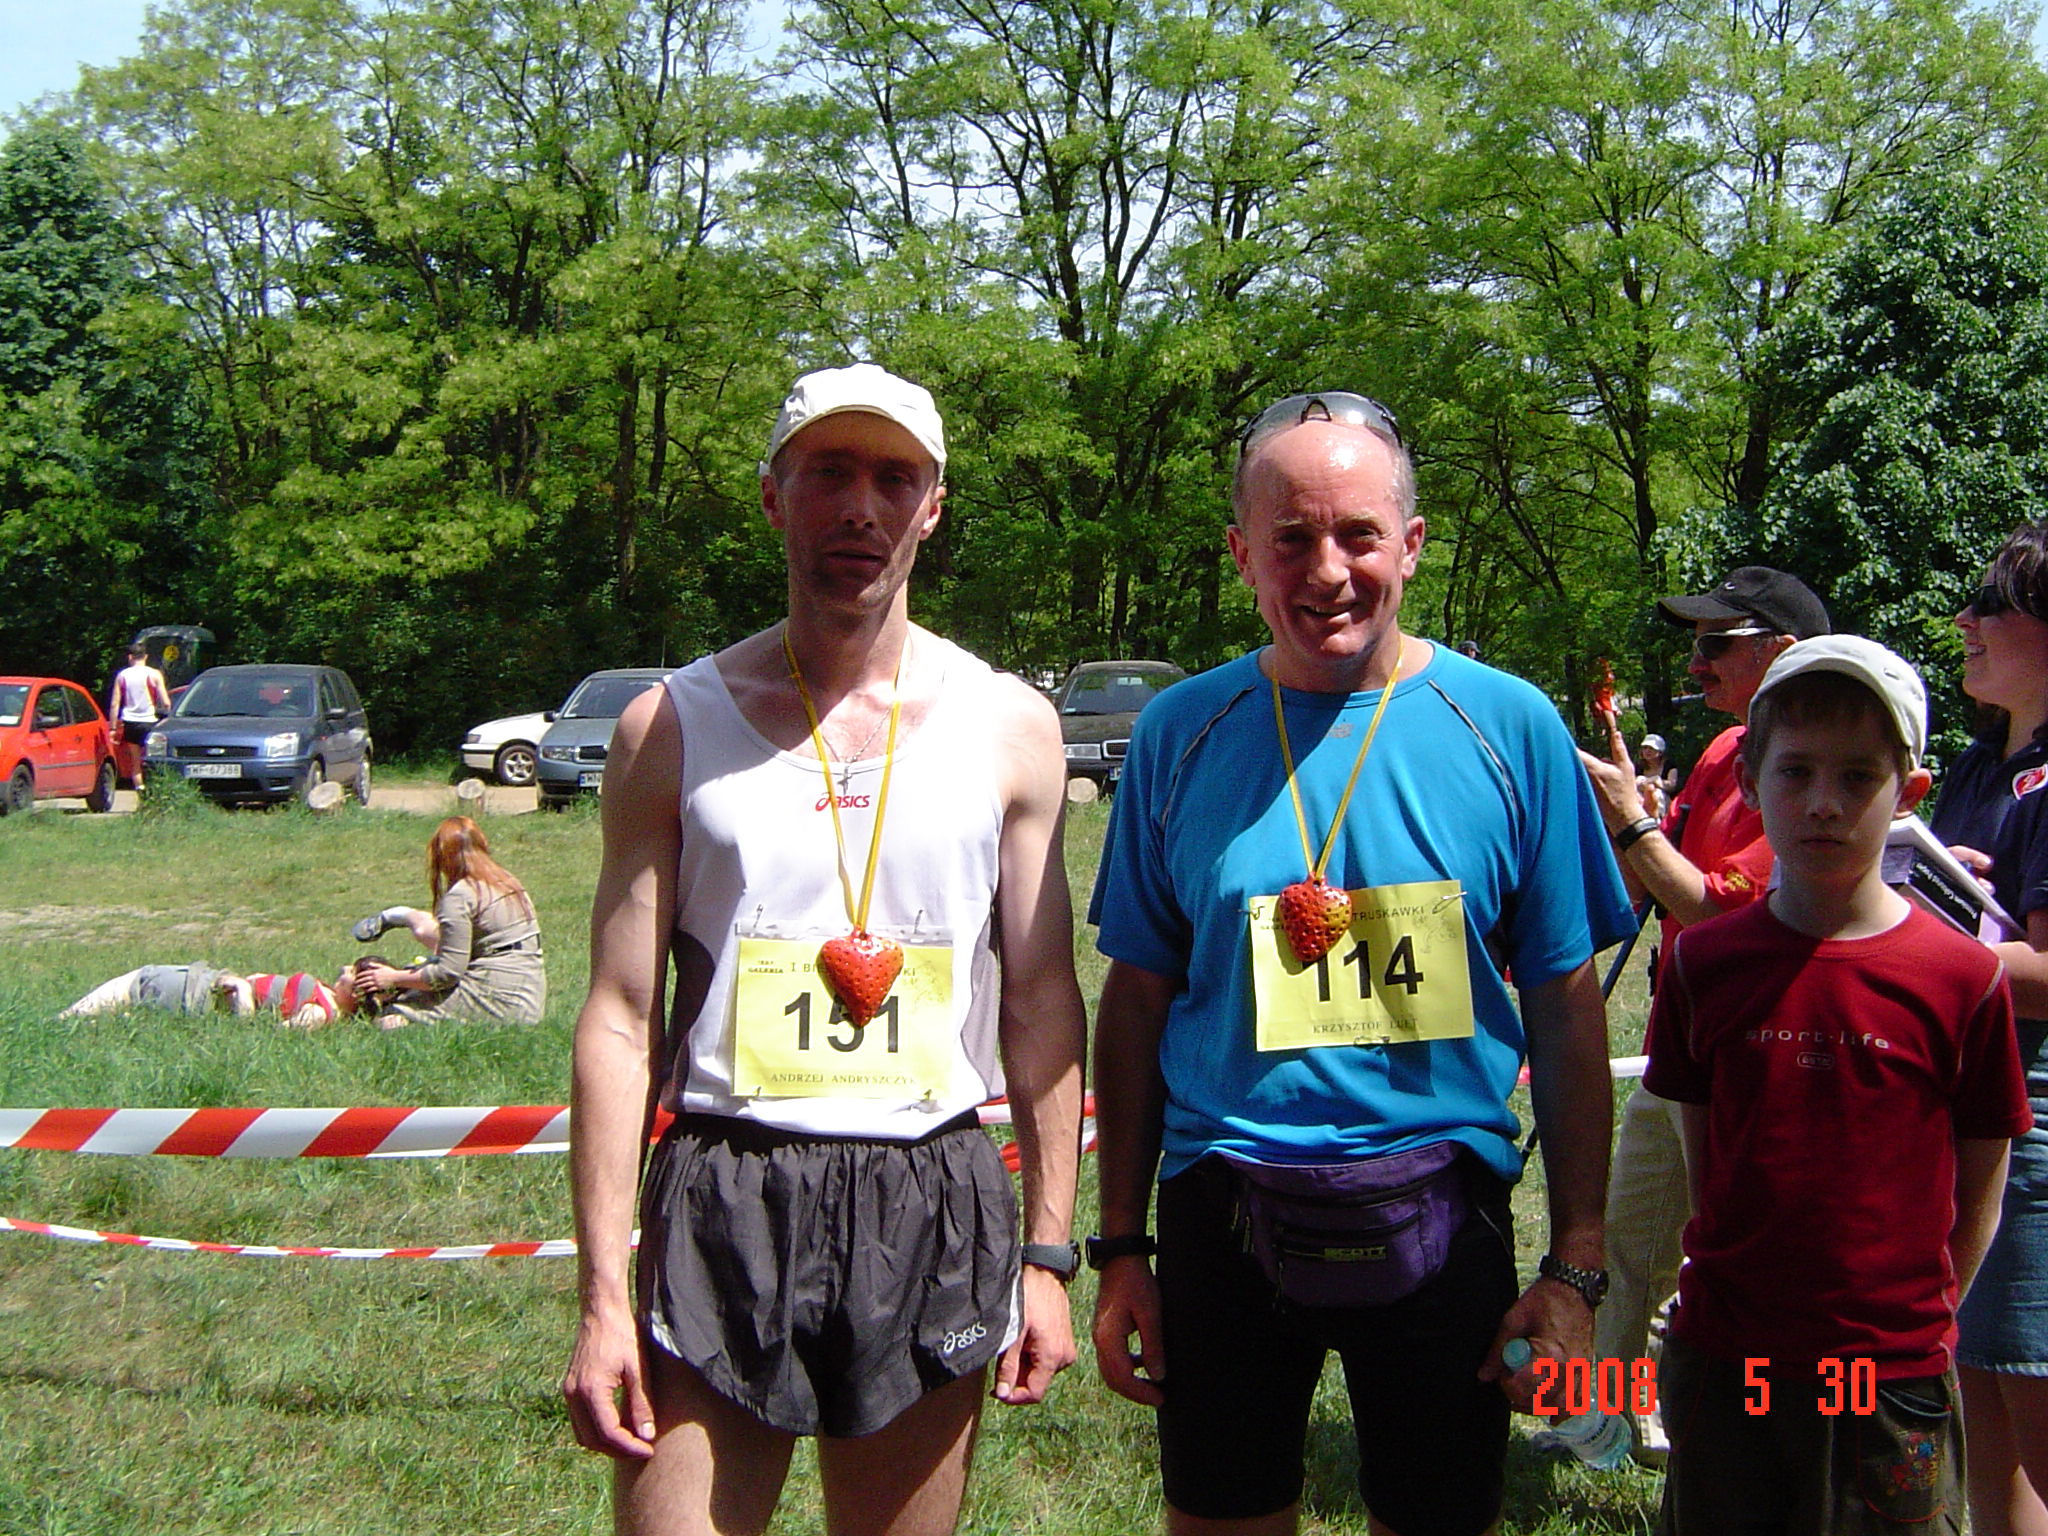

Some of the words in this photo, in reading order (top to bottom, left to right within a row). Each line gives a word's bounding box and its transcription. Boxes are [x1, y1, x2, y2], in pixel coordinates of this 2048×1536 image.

[1352, 906, 1424, 921] TRUSKAWKI
[1303, 935, 1424, 1003] 114
[784, 991, 900, 1054] 151
[1312, 1022, 1381, 1034] KRZYSZTOF
[770, 1073, 825, 1083] ANDRZEJ
